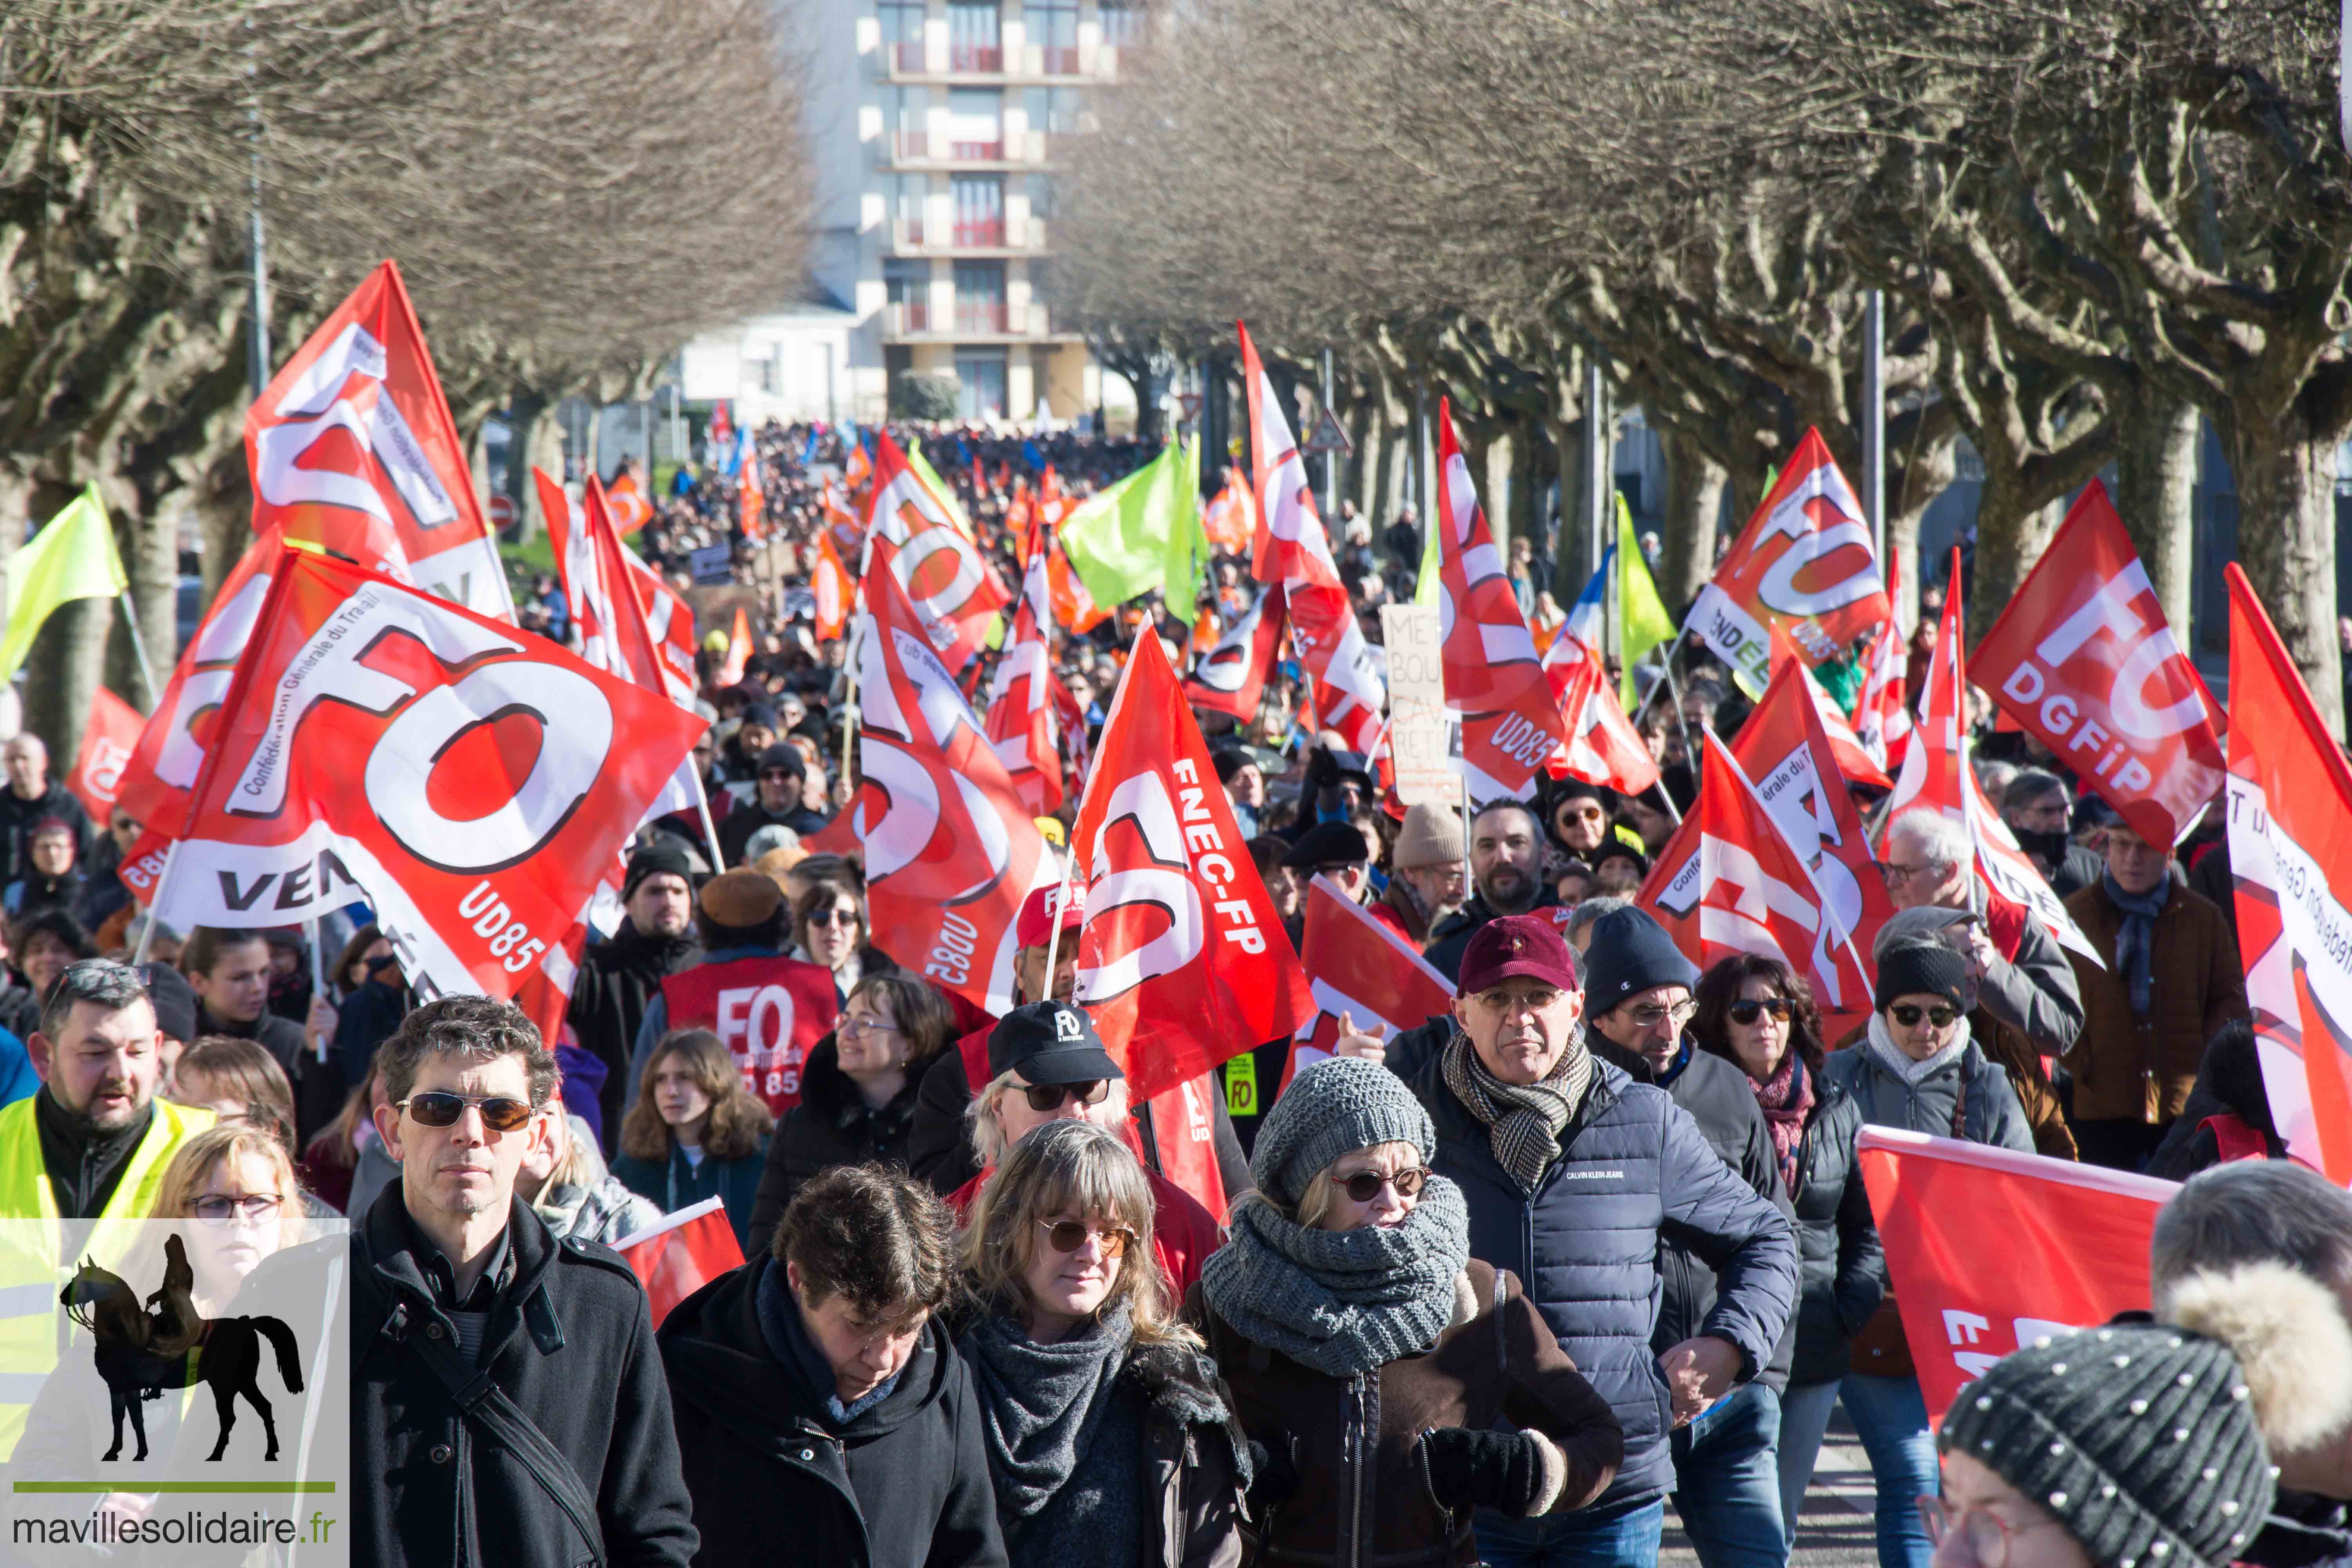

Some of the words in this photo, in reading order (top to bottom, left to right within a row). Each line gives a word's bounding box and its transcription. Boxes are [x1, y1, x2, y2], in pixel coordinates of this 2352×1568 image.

[223, 580, 614, 877] FO
[243, 692, 292, 797] Confédération
[284, 637, 335, 690] Générale
[327, 621, 348, 645] du
[1490, 710, 1559, 768] UD85
[2001, 661, 2152, 793] DGFiP
[1171, 758, 1267, 955] FNEC-FP
[458, 880, 546, 973] UD85
[716, 984, 795, 1055] FO
[1054, 1010, 1080, 1035] FO
[766, 1071, 800, 1096] 85
[1231, 1080, 1252, 1109] FO
[1605, 1170, 1624, 1178] JEANS
